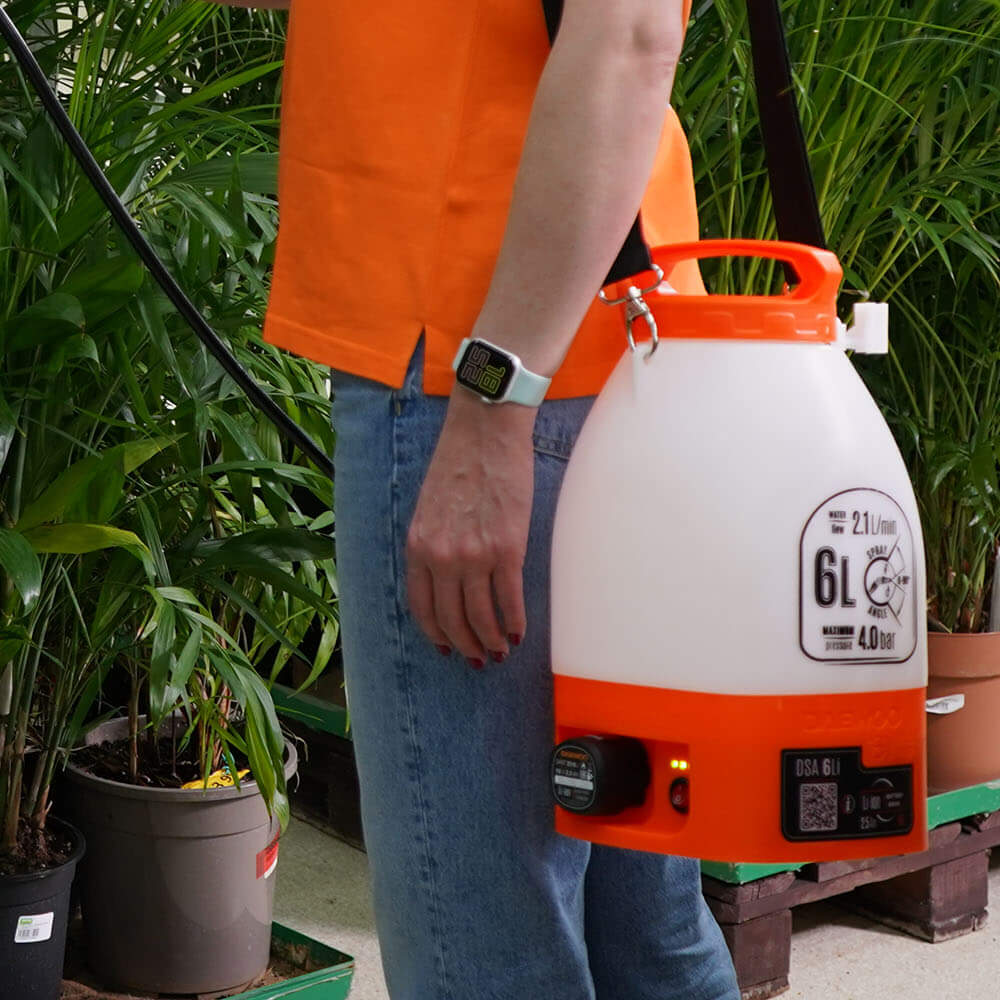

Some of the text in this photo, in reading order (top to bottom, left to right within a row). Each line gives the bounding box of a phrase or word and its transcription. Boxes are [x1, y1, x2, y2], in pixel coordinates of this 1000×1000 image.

[853, 511, 869, 535] 2.1
[867, 606, 888, 619] ANGLE
[823, 626, 855, 635] MAXIMUM
[858, 625, 896, 650] 4.0 bar
[796, 758, 819, 777] DSA
